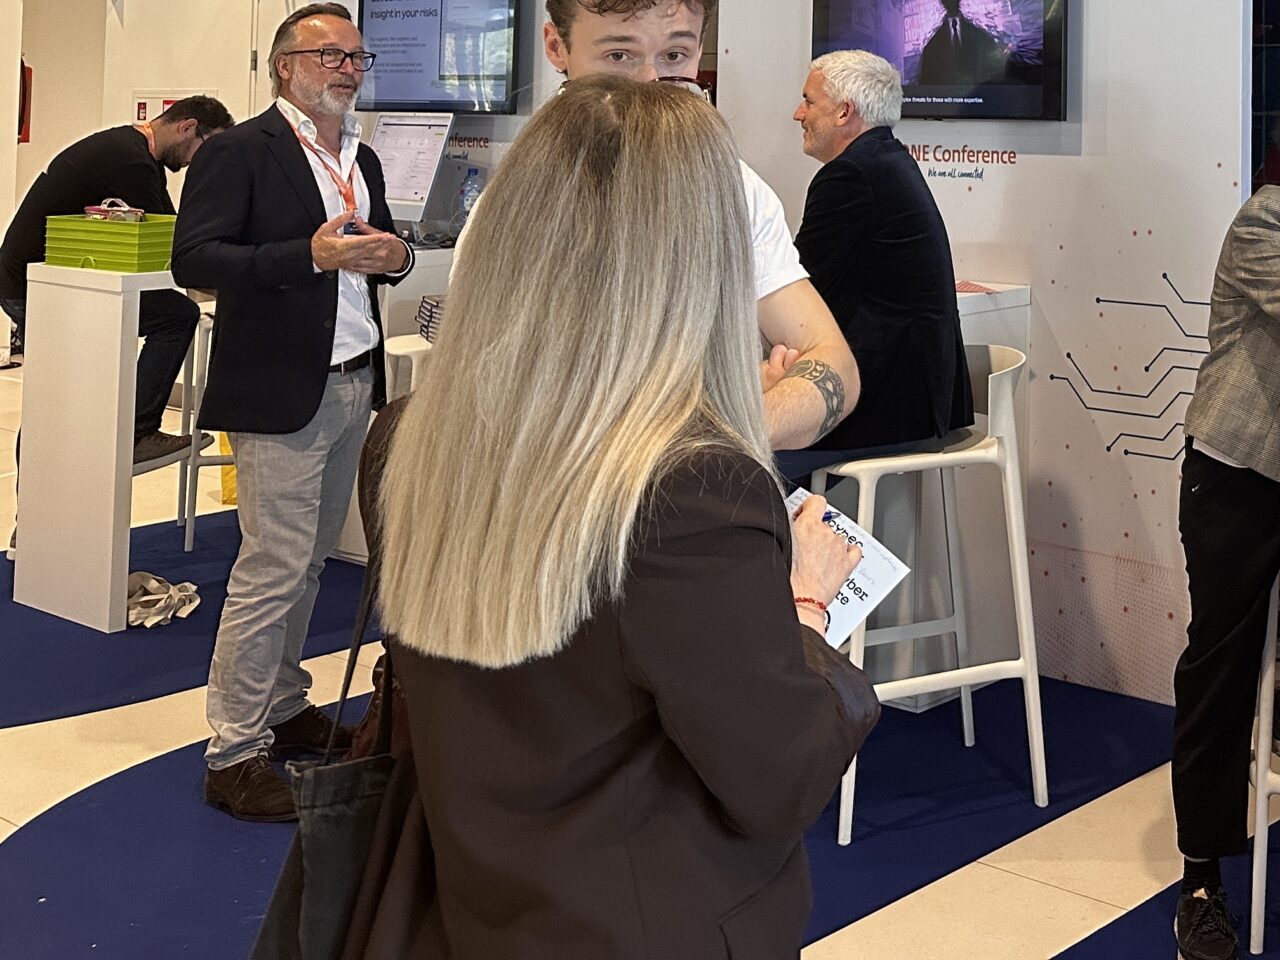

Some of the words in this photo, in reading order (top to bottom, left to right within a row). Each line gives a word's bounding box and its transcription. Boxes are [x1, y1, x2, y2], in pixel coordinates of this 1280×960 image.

[401, 9, 419, 20] your
[419, 8, 438, 17] risks
[448, 132, 489, 149] nference
[933, 144, 1017, 164] Conference
[845, 578, 869, 601] ber
